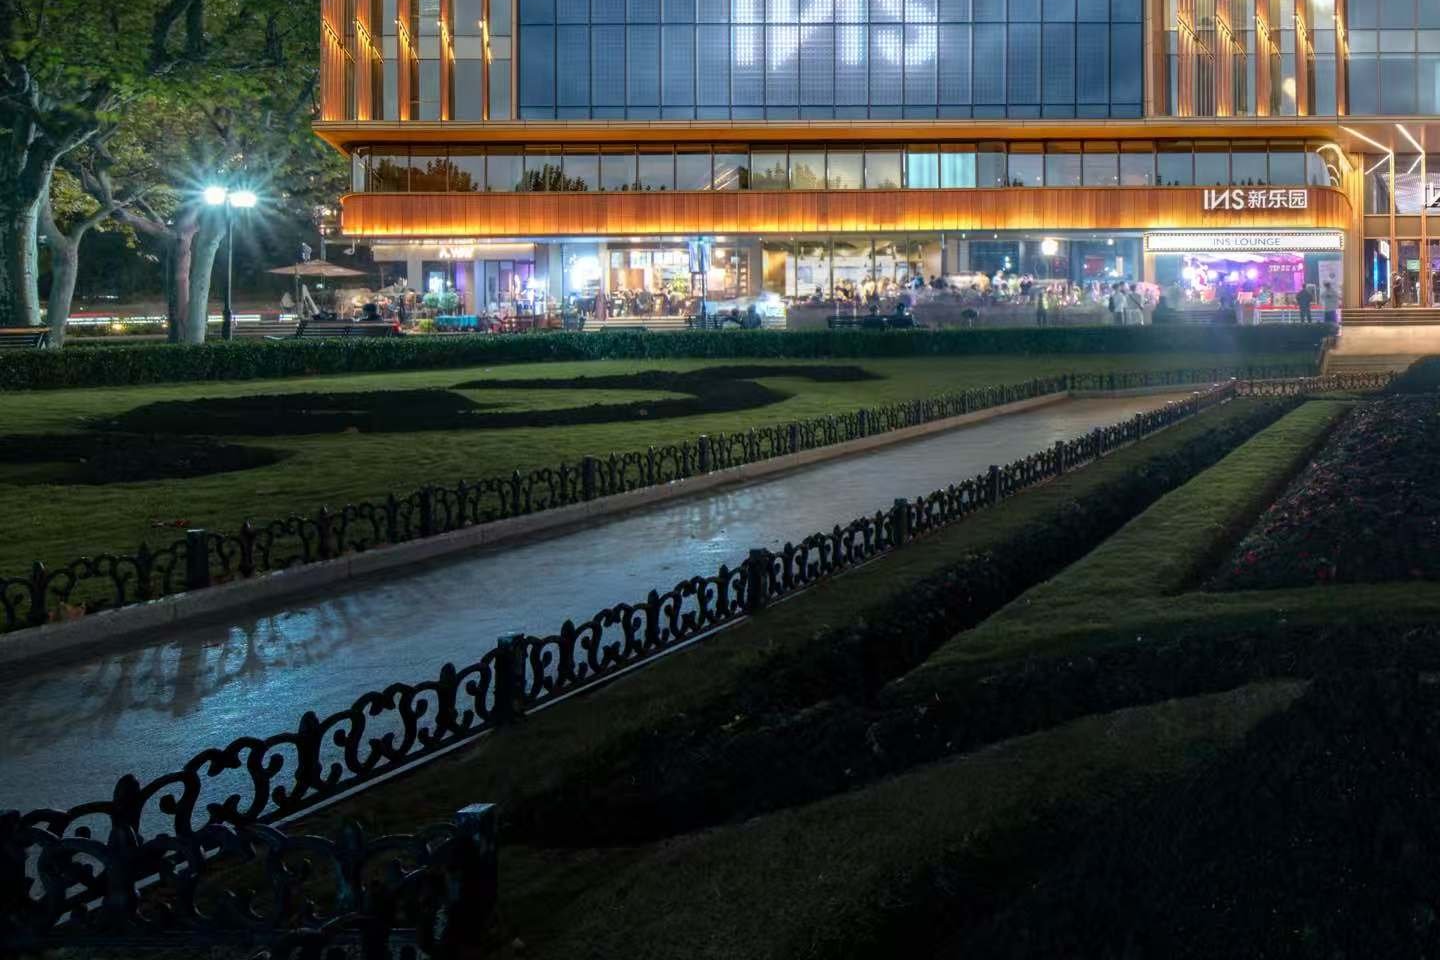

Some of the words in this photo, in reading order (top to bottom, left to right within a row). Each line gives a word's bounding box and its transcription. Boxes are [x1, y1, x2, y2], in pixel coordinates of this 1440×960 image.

[1203, 189, 1245, 210] INS
[1247, 189, 1308, 209] 新乐园
[1213, 237, 1232, 246] INS
[1234, 237, 1281, 246] LOUNGE
